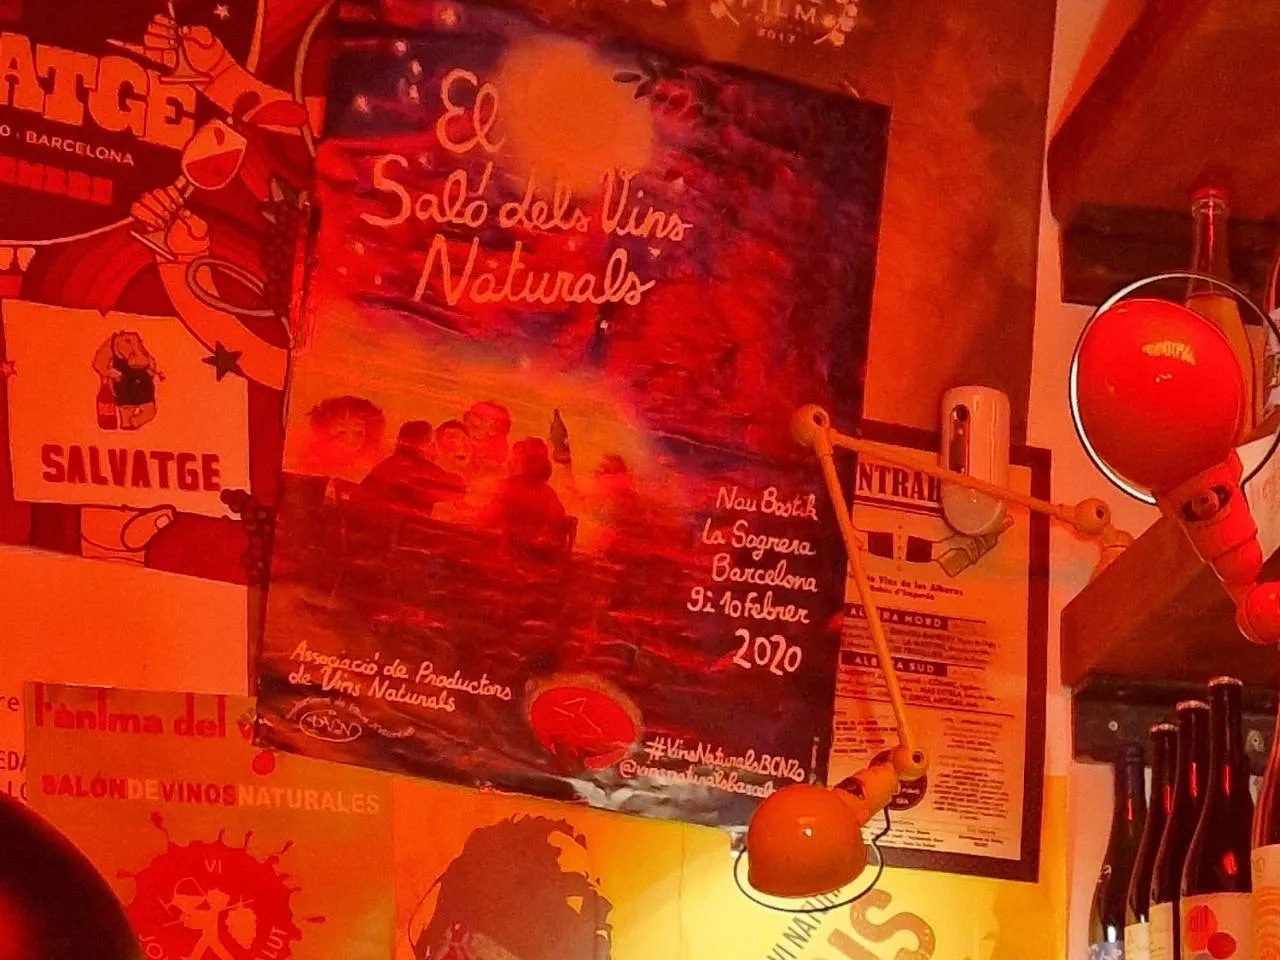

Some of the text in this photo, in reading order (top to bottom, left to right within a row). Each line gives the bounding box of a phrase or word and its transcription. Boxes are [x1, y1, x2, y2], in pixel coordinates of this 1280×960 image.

[437, 68, 505, 154] El
[26, 130, 135, 167] BARCELONA
[360, 154, 693, 241] Saló dels Vins
[413, 233, 655, 306] Naturals
[41, 443, 221, 492] SALVATGE
[711, 551, 818, 593] Barcelona
[288, 638, 513, 702] Associació de Productors
[732, 627, 803, 677] 2020
[287, 664, 313, 686] de
[367, 675, 456, 713] Naturals
[204, 858, 223, 875] VI
